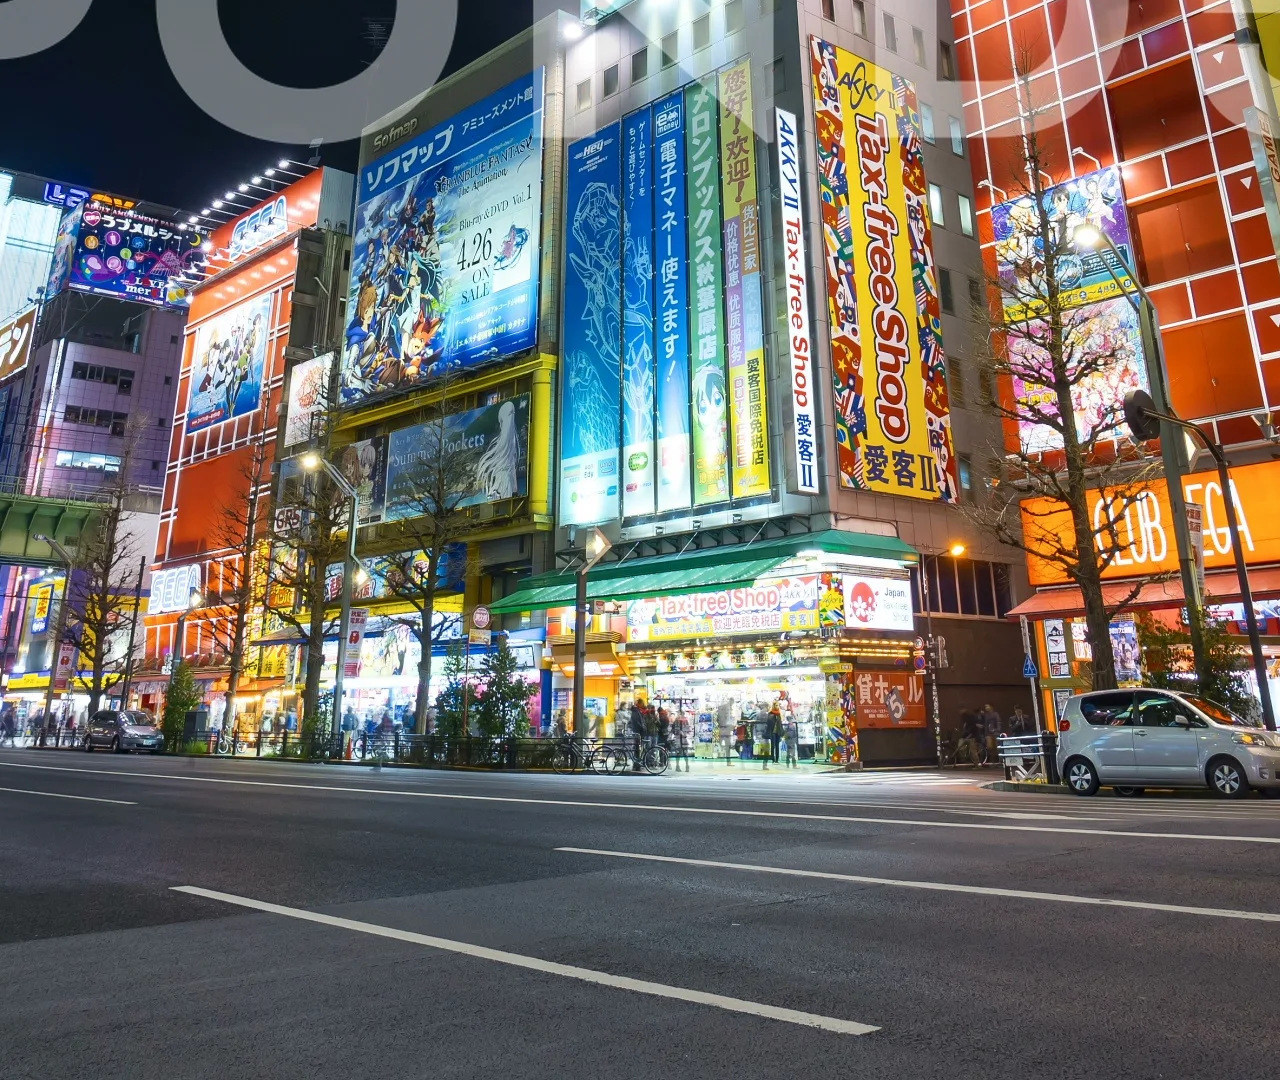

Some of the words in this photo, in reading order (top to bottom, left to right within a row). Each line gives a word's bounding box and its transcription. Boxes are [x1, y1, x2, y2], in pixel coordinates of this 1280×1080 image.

[372, 116, 419, 153] Sofmap
[582, 138, 604, 158] Hey
[366, 124, 456, 193] ソフマップ
[101, 214, 183, 241] ラブメルシー
[490, 199, 510, 219] DVD
[457, 227, 493, 272] 4.26
[742, 204, 757, 271] 货比三家
[472, 264, 492, 284] ON
[659, 137, 682, 383] 電子マネー使えます!
[784, 216, 804, 332] Tax-free
[461, 281, 491, 306] SALE
[792, 331, 810, 408] Shop
[440, 431, 486, 458] Pockets
[1094, 491, 1168, 567] CLUB
[147, 563, 202, 616] SEGA
[657, 593, 728, 619] Tax-free
[730, 587, 779, 615] Shop
